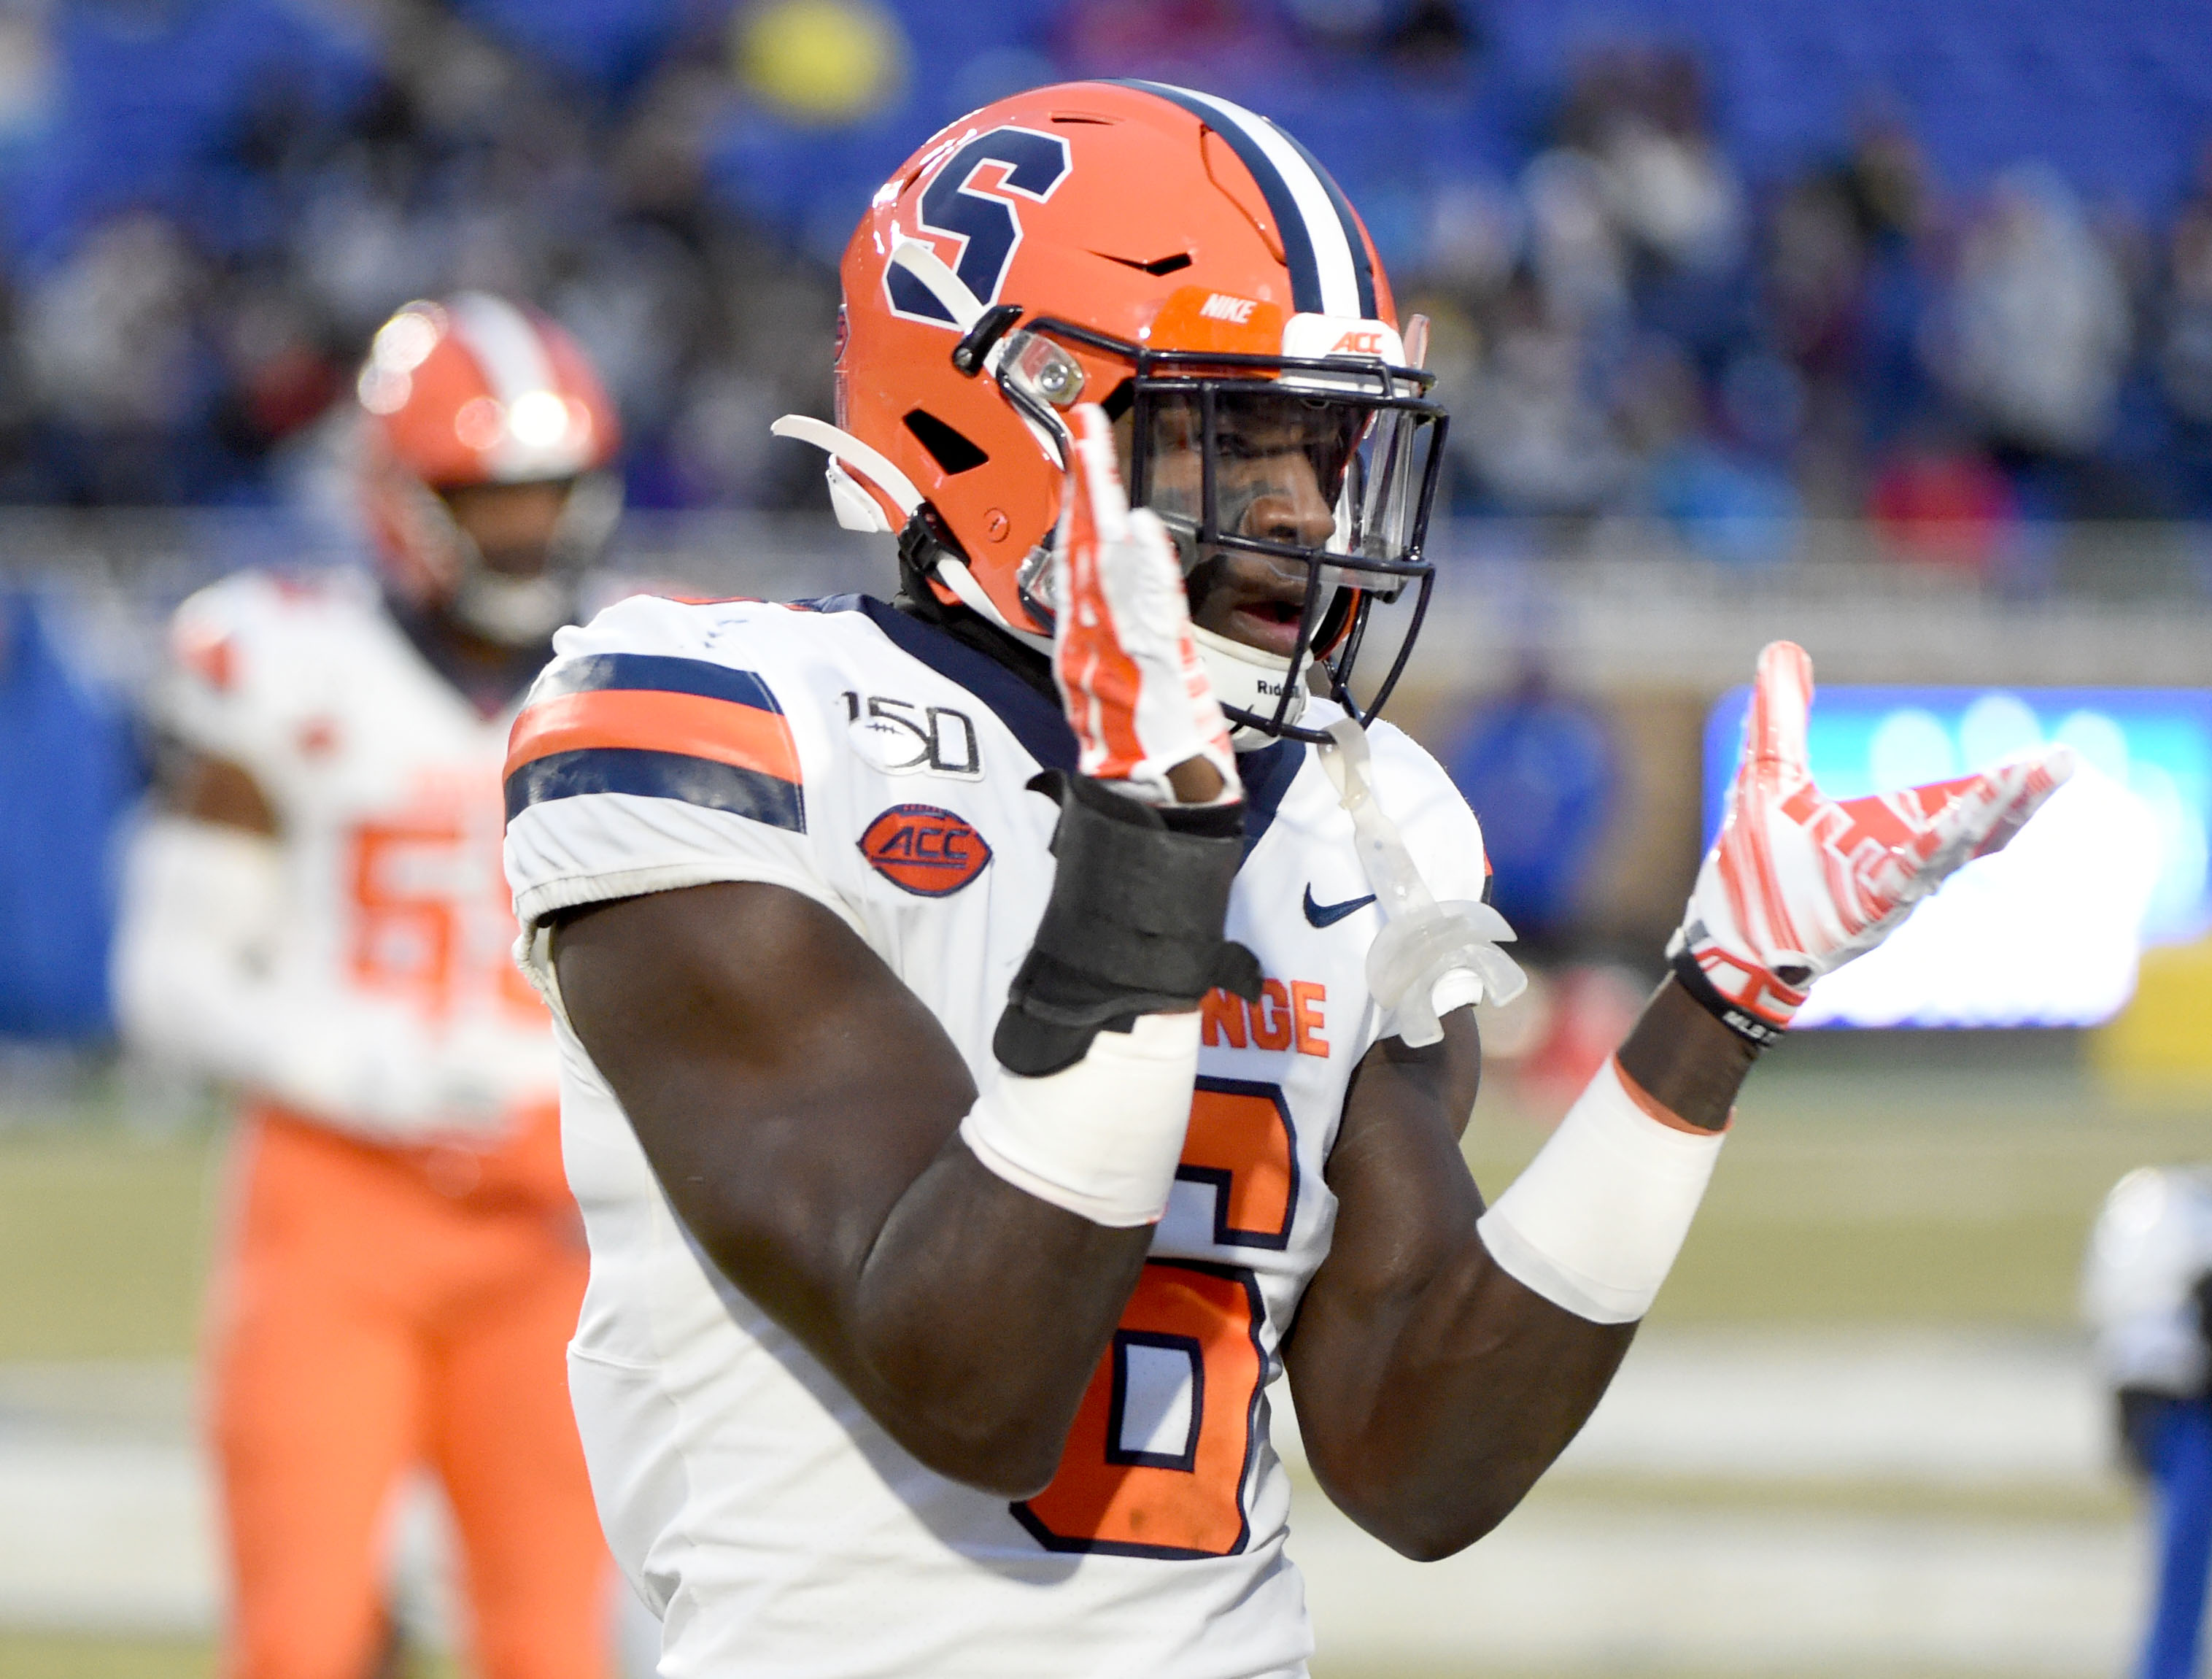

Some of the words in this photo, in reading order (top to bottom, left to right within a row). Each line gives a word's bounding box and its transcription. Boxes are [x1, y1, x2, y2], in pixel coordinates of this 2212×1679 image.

[881, 125, 1073, 333] S
[1199, 293, 1258, 324] NIKE
[1331, 332, 1383, 354] ACC
[840, 691, 979, 774] 150
[878, 826, 971, 860] ACC
[1199, 978, 1329, 1058] NGE
